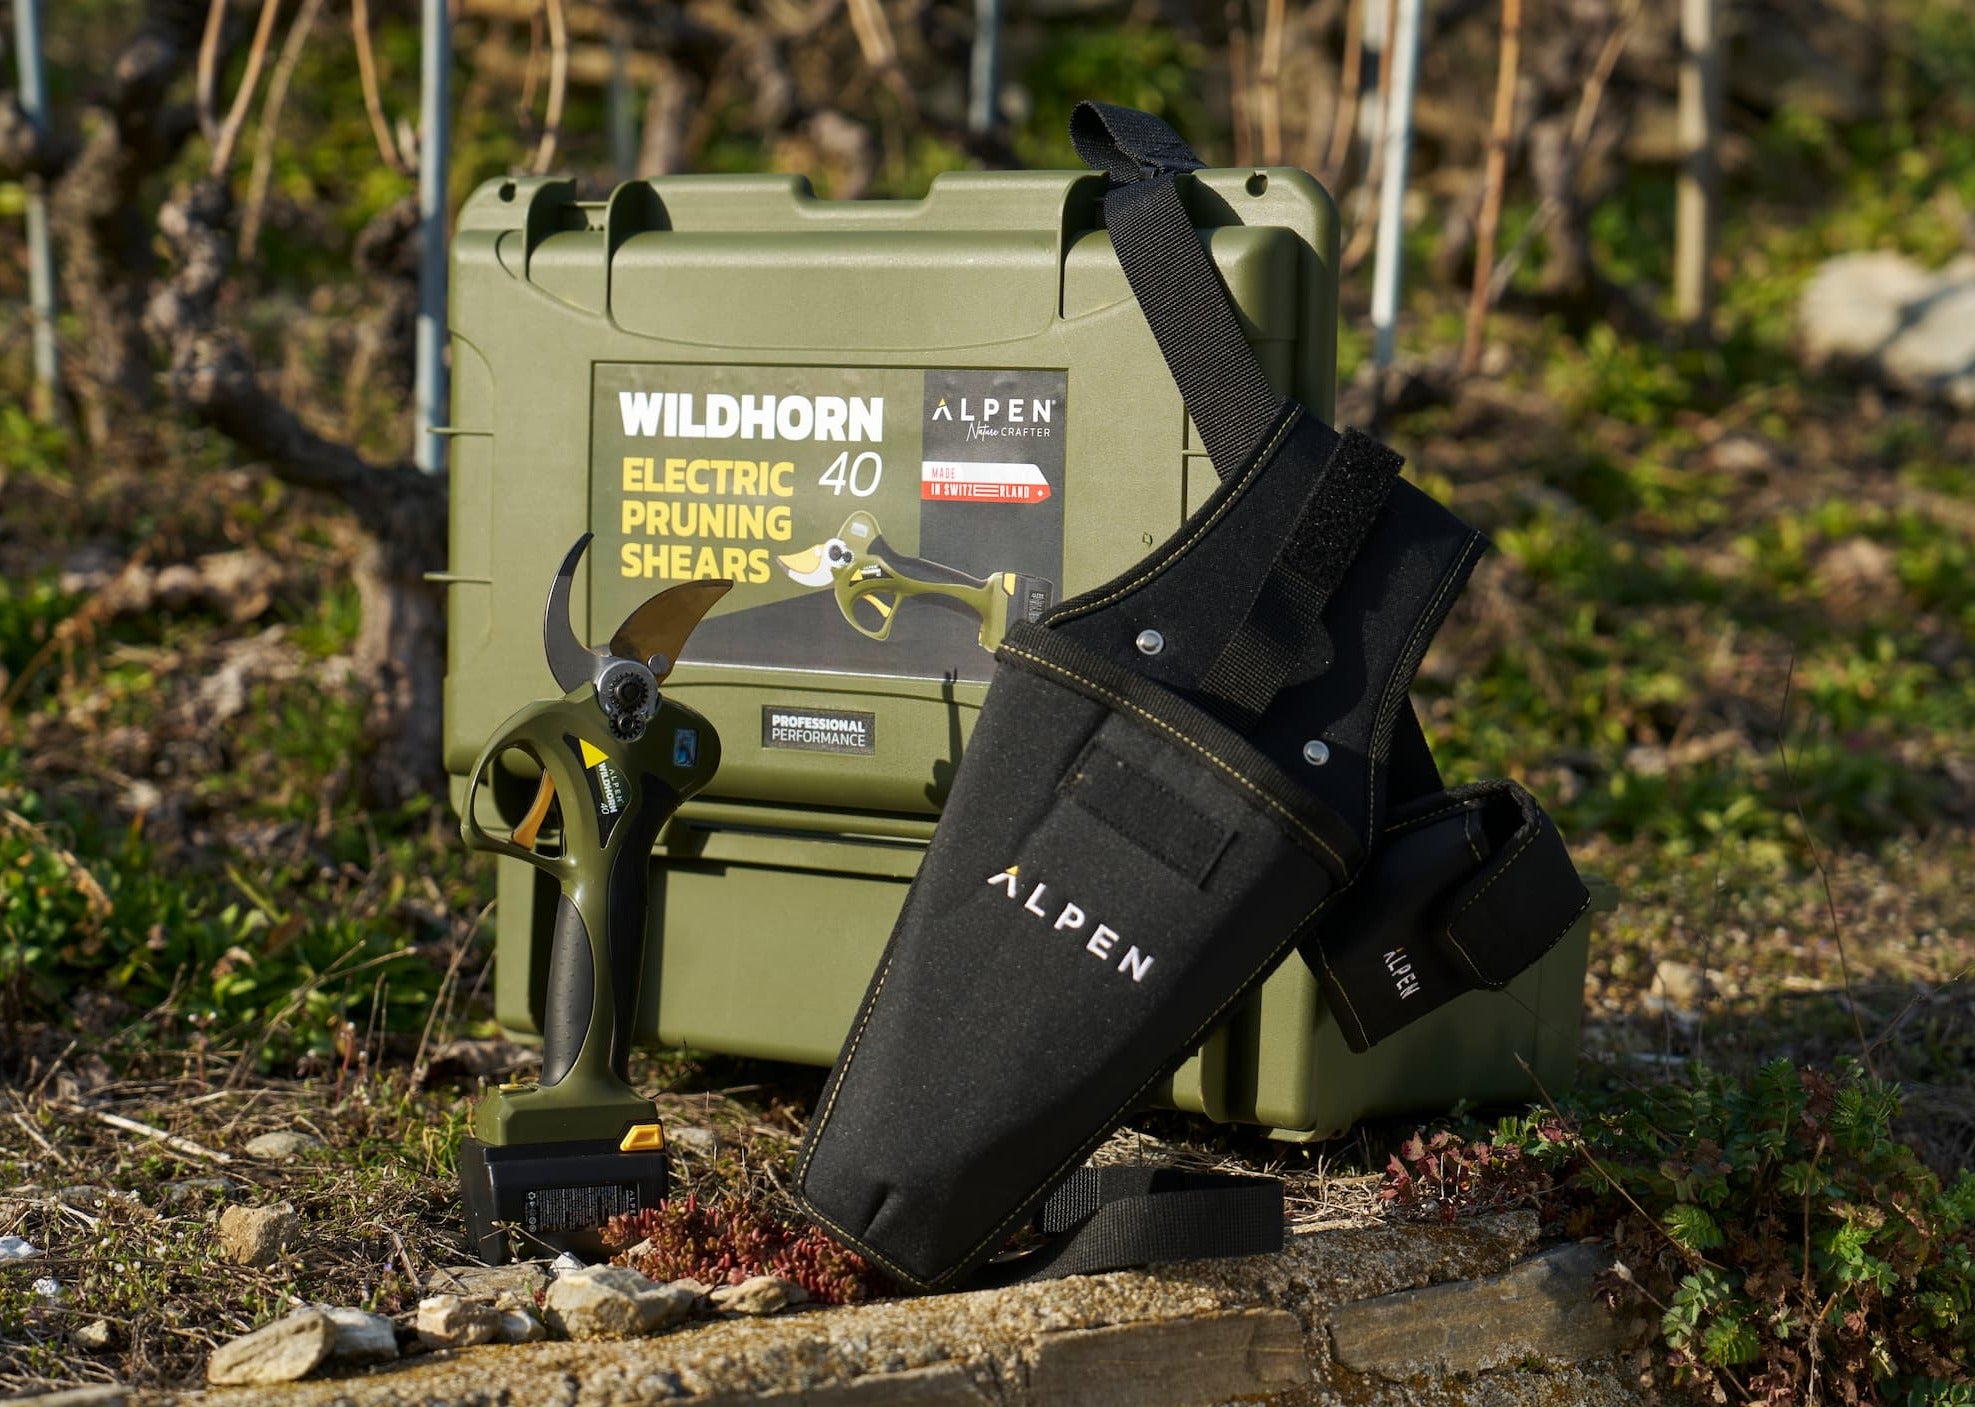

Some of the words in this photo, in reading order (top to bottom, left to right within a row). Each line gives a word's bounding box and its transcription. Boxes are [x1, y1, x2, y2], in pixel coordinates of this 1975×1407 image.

[619, 392, 884, 442] WILDHORN
[932, 398, 1051, 422] ALPEN
[966, 421, 999, 442] Nature
[1000, 427, 1051, 437] CRAFTER
[622, 457, 795, 497] ELECTRIC
[818, 451, 882, 497] 40
[930, 484, 941, 496] IN
[944, 484, 1030, 499] SWITZERLAND
[931, 467, 955, 479] MADE
[621, 500, 792, 541] PRUNING
[621, 543, 770, 584] SHEARS
[772, 714, 866, 733] PROFESSIONAL
[772, 727, 866, 747] PERFORMANCE
[598, 762, 618, 814] WILDHORN
[608, 768, 622, 802] ALPEN
[600, 802, 610, 815] 40
[987, 864, 1155, 983] ALPEN
[1383, 946, 1420, 1000] ALPEN
